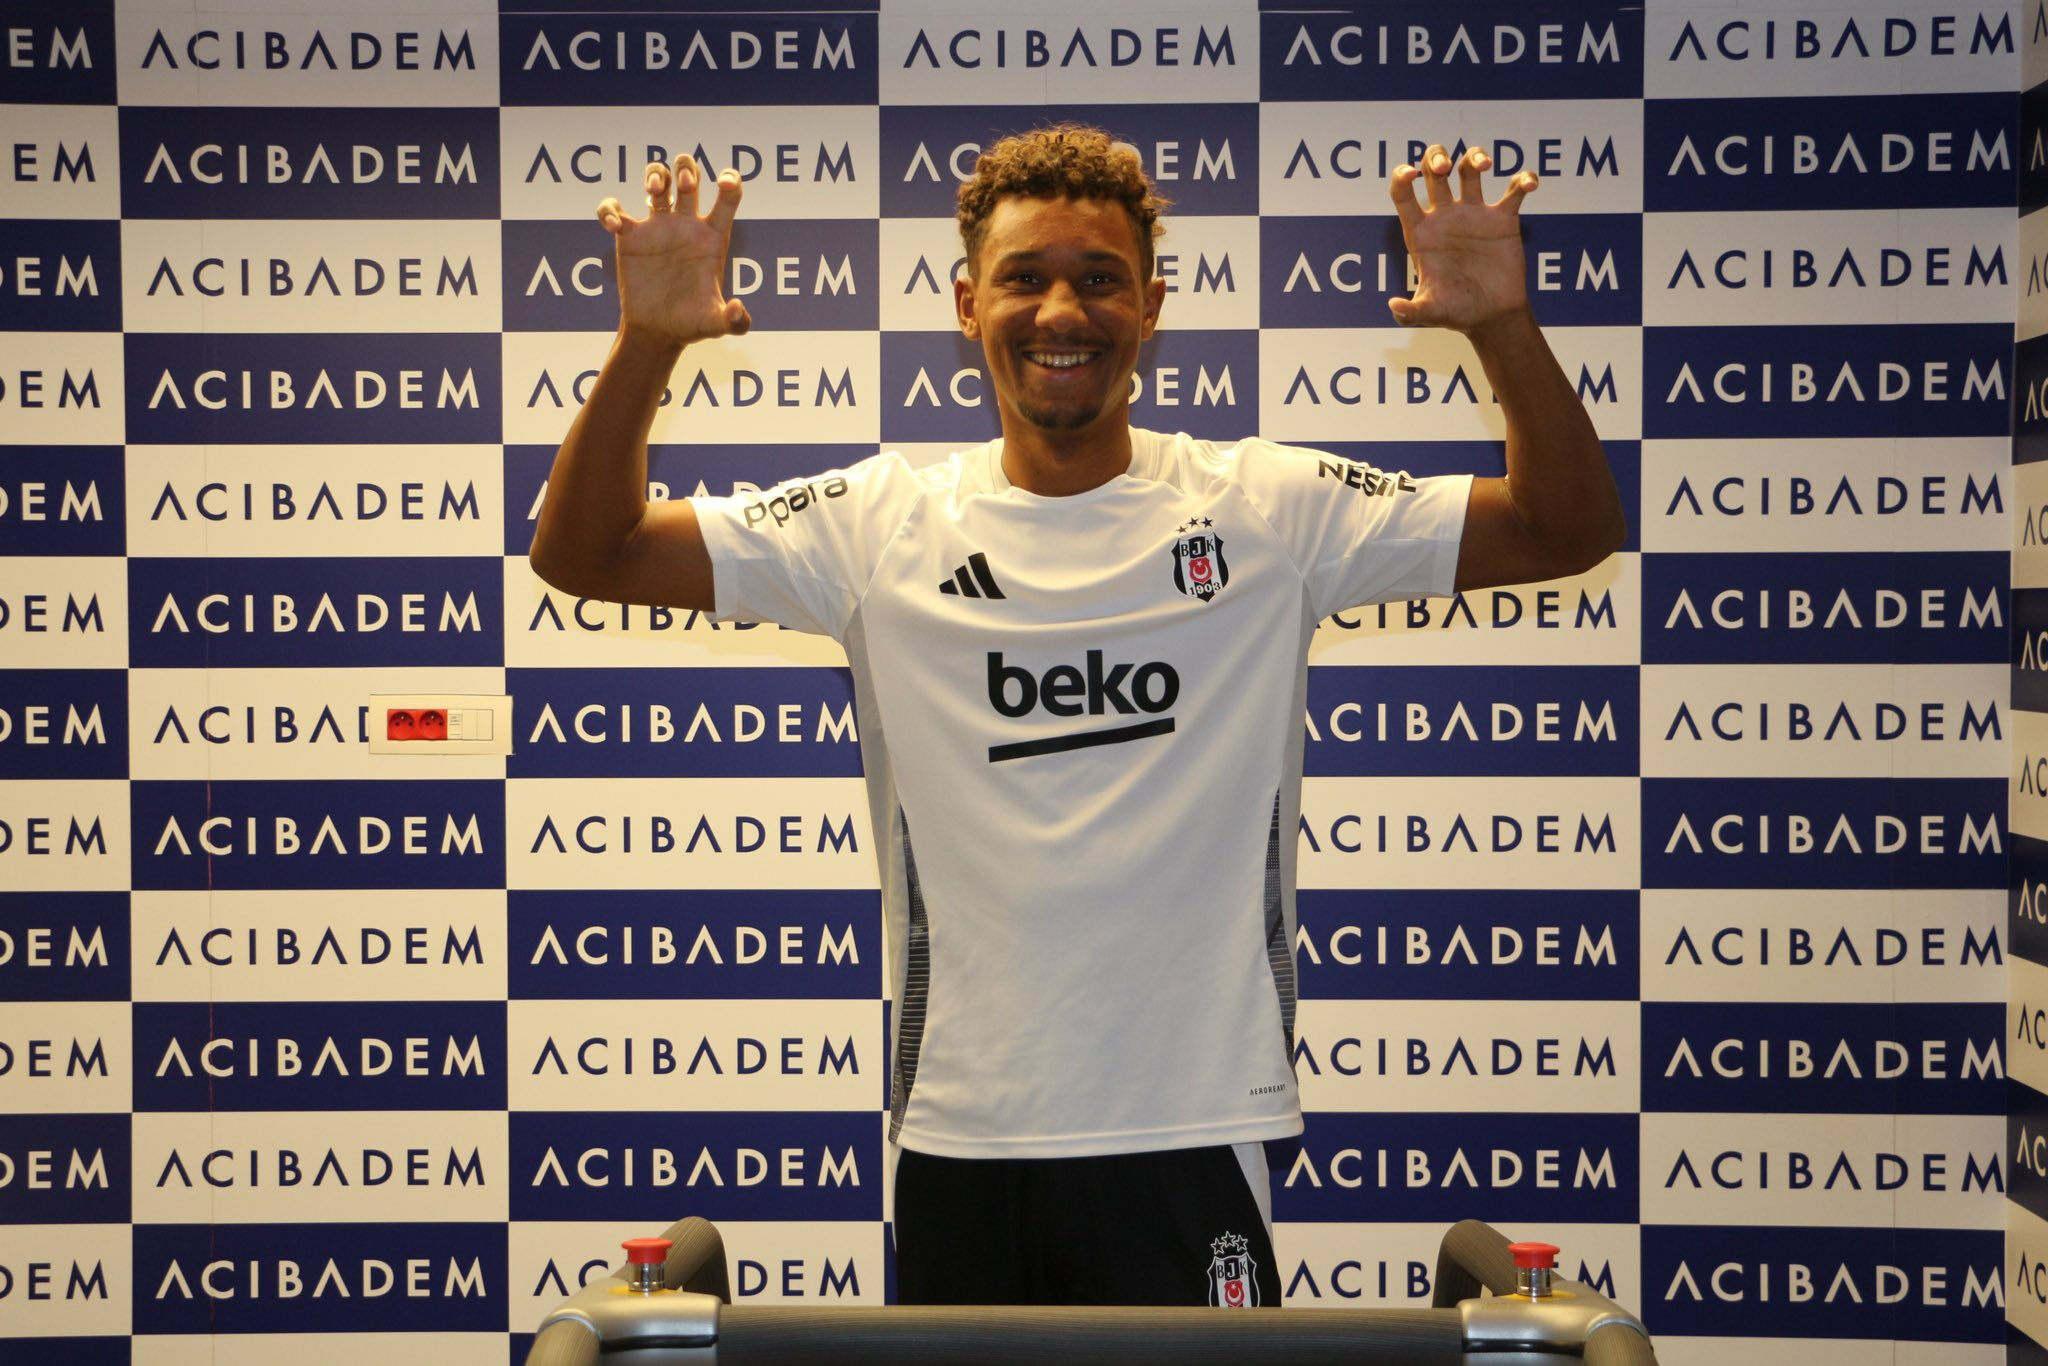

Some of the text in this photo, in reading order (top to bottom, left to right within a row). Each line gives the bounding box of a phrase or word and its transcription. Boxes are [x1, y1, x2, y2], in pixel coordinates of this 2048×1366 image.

[9, 28, 92, 68] EM
[141, 30, 475, 70] ACIBADEM
[524, 29, 855, 70] ACIBADEM
[904, 26, 1235, 68] ACIBADEM
[1284, 22, 1619, 65] ACIBADEM
[1670, 12, 2014, 60] ACIBADEM
[14, 143, 95, 182] EM
[145, 143, 477, 184] ACIBADEM
[1668, 130, 2010, 175] ACIBADEM
[147, 257, 477, 296] ACIBADEM
[526, 254, 856, 296] ACDEM
[1283, 249, 1619, 293] ACIEM
[1668, 245, 2007, 288] ACIBADEM
[149, 368, 479, 409] ACIBADEM
[1284, 362, 1618, 404] ACIBAM
[1667, 360, 2005, 403] ACIBADEM
[151, 482, 479, 521] ACIBADEM
[1666, 474, 2003, 515] ACIBADEM
[1189, 582, 1221, 595] 1903
[1665, 588, 2002, 629] ACIBADEM
[152, 592, 481, 633] ACIBADEM
[987, 649, 1180, 718] beko
[530, 702, 857, 743] ACIBADEM
[1666, 701, 2002, 741] ACIBADEM
[155, 814, 483, 855] ACIBADEM
[531, 815, 858, 853] ACIBADEM
[1298, 813, 1616, 853] ACIBADEM
[1665, 814, 2001, 854] ACIBADEM
[156, 926, 483, 966] ACIBADEM
[531, 924, 859, 965] ACIBADEM
[1296, 924, 1617, 967] ACIBADEM
[1665, 925, 2003, 967] ACIBADEM
[156, 1036, 484, 1077] ACIBADEM
[532, 1036, 859, 1075] ACIBADEM
[1294, 1036, 1616, 1077] ACIBADEM
[1665, 1037, 2003, 1079] ACIBADEM
[157, 1148, 484, 1187] ACIBADEM
[532, 1146, 860, 1187] ACIBADEM
[1285, 1148, 1616, 1188] ACIBADEM
[1664, 1149, 2004, 1191] ACIBADEM
[156, 1257, 486, 1299] ACIBADEM
[533, 1256, 861, 1297] ACDEM
[1217, 1261, 1248, 1279] BJK
[1665, 1261, 2004, 1308] ACIBADEM
